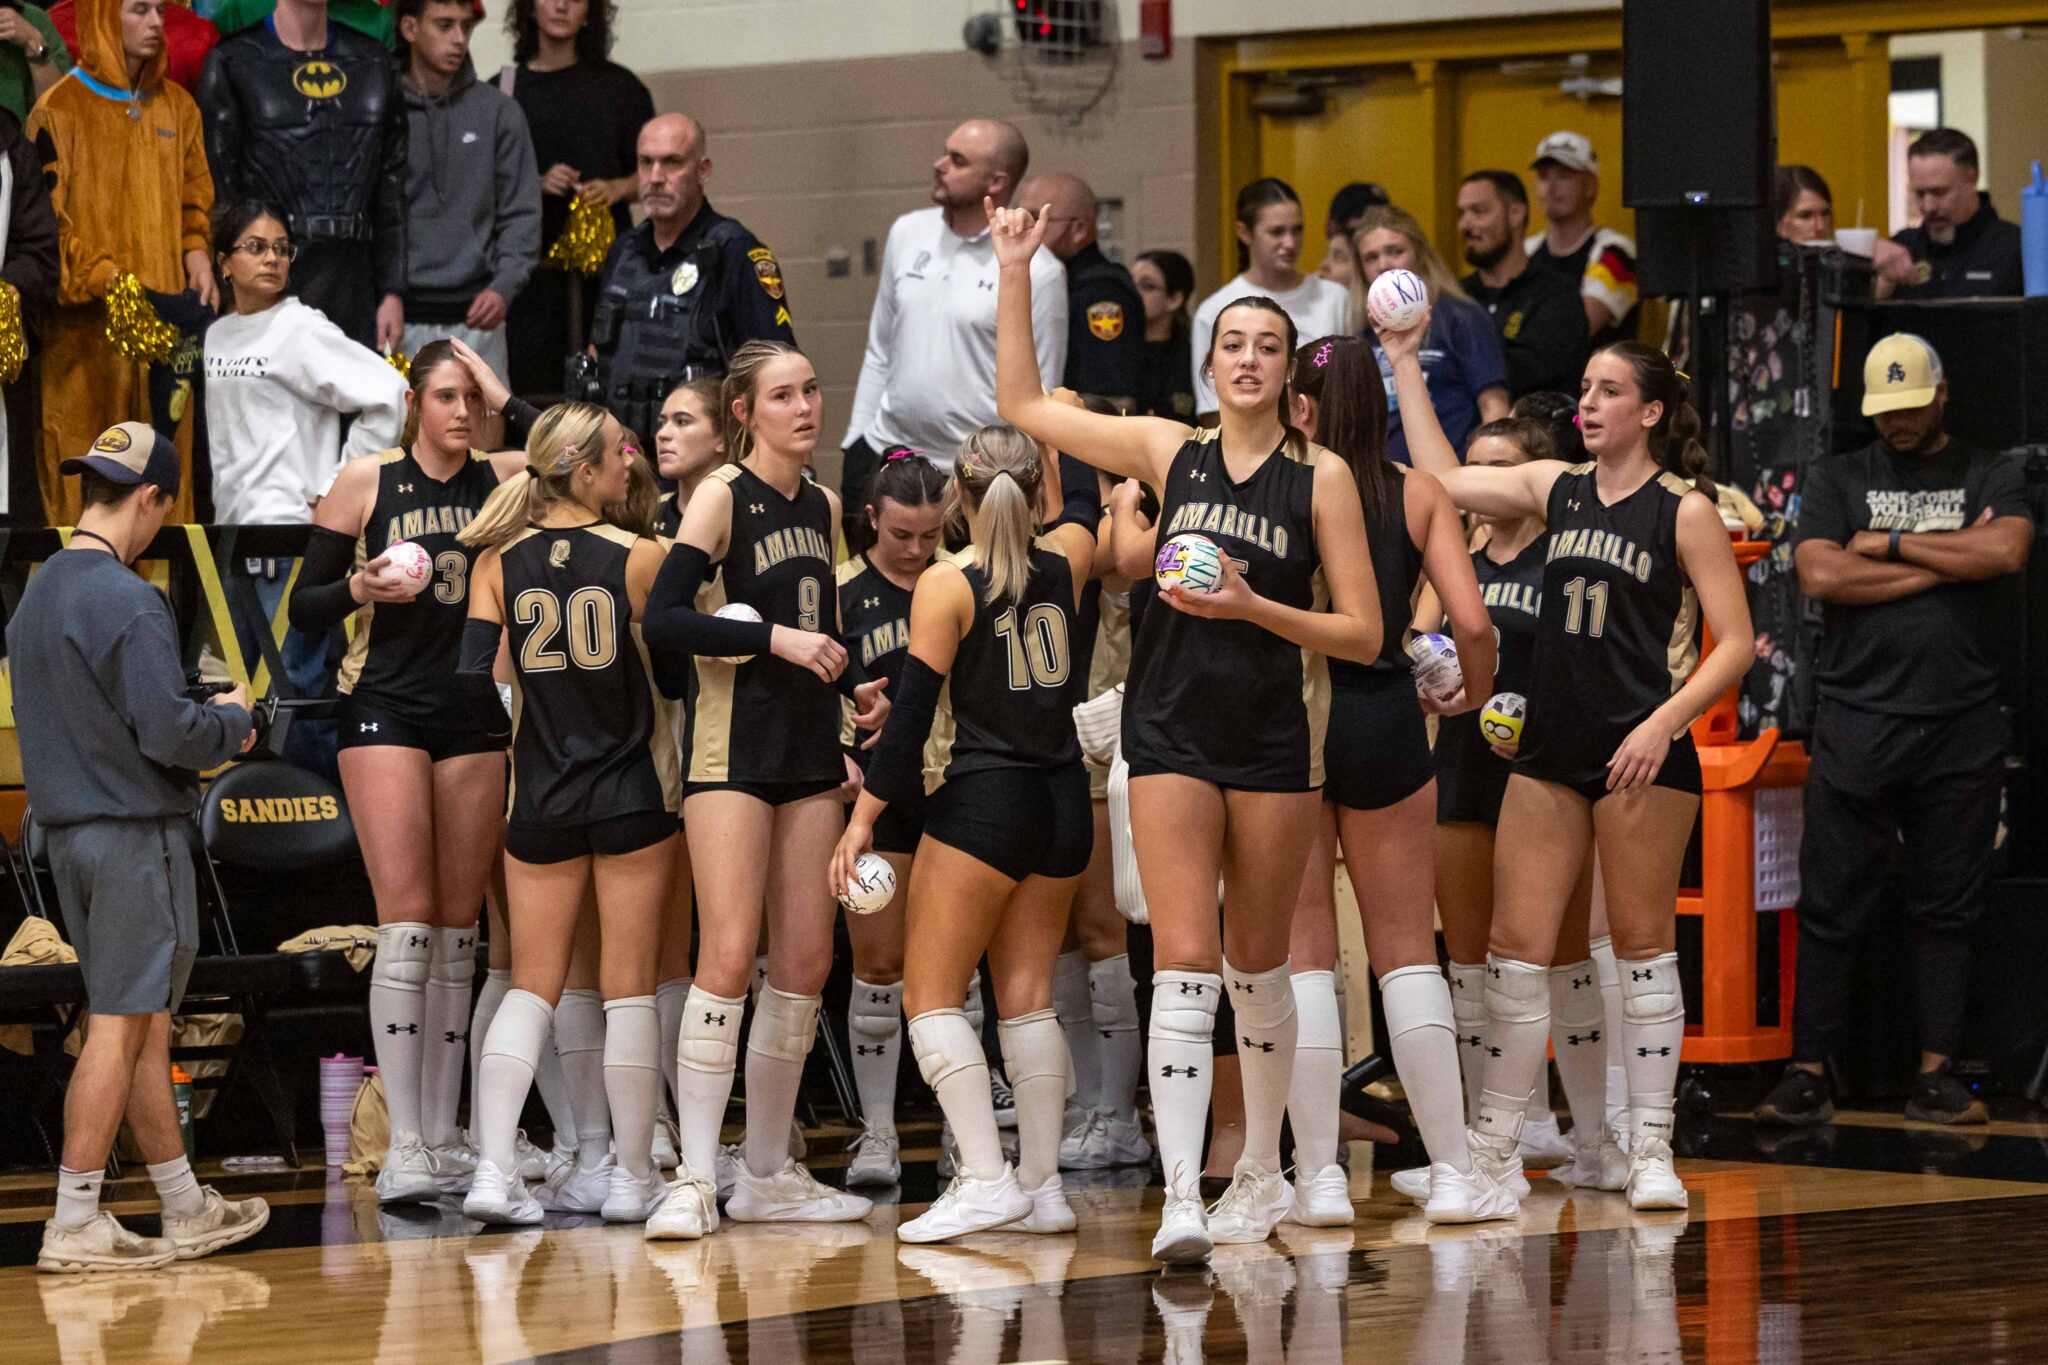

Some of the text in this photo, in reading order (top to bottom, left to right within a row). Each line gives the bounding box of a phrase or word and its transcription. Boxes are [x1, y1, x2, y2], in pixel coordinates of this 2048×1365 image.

[1166, 502, 1288, 559] AMARILLO
[1869, 502, 1965, 521] VOLLBALL
[435, 550, 467, 604] 3
[798, 576, 821, 633] 9
[514, 586, 617, 673] 20
[1563, 576, 1609, 637] 11
[994, 603, 1070, 690] 10
[220, 795, 339, 823] SANDIES
